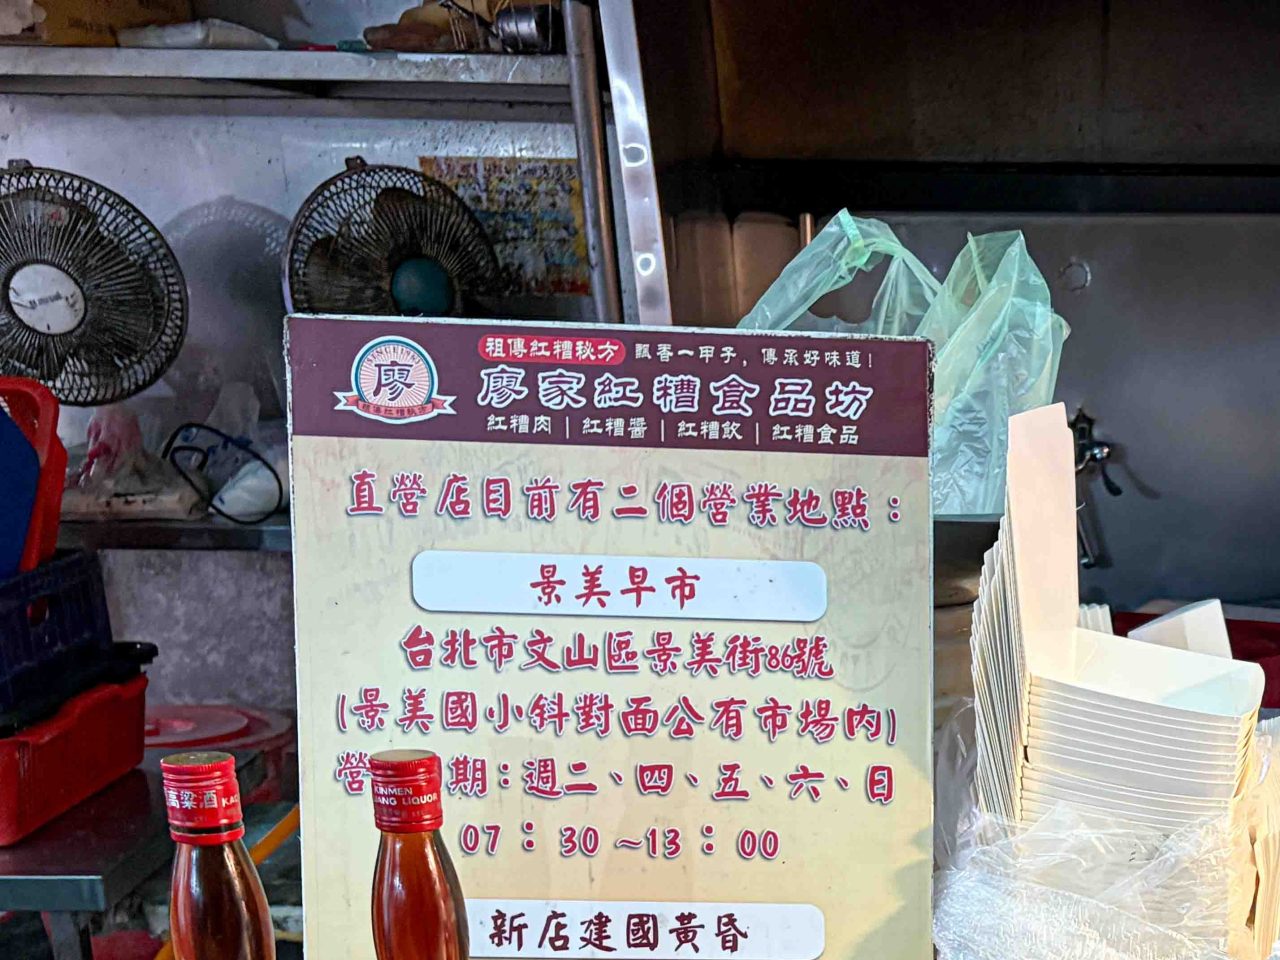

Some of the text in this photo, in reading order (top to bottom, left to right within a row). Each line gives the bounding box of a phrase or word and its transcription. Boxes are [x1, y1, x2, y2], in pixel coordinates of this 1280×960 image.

[485, 337, 620, 362] 祖傳紅糟秘方
[373, 361, 415, 401] 廖
[477, 364, 873, 419] 廖家紅糟食品坊
[486, 414, 859, 445] 紅糟肉 紅糟醬 紅糟飲 紅糟食品
[347, 469, 902, 529] 直營店目前有二個營業地點：
[530, 563, 701, 609] 景美早市
[401, 626, 835, 678] 台北市文山區景美街86號
[336, 752, 895, 804] 營期：週二、四、五、六、日
[402, 793, 438, 806] LIQUOR
[489, 910, 750, 954] 新店建國黃昏
